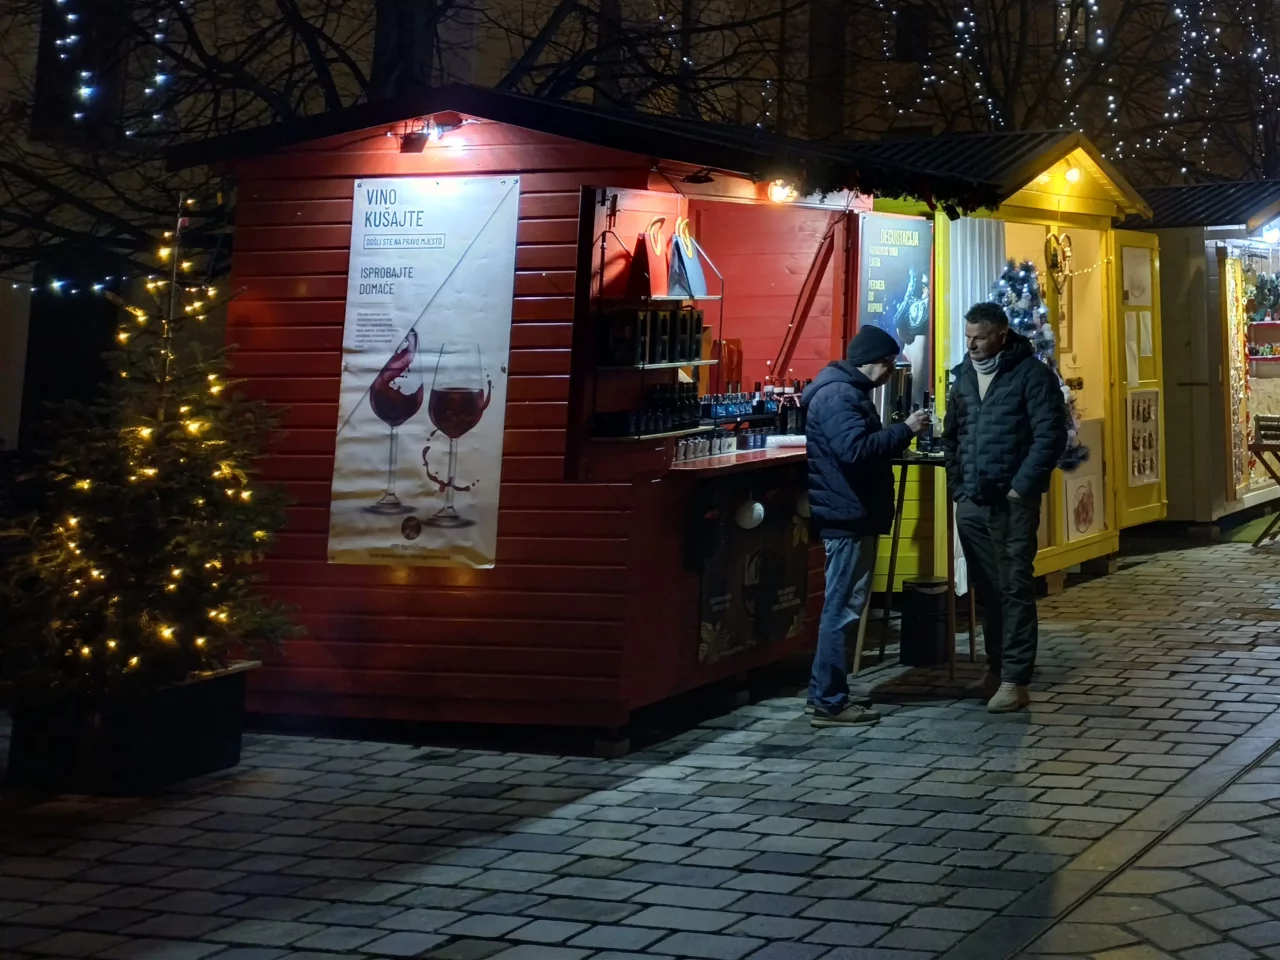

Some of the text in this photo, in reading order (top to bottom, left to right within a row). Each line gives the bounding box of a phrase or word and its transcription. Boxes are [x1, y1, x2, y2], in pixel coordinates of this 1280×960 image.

[367, 188, 397, 206] VINO
[364, 206, 424, 228] KUŠAJTE
[366, 237, 442, 246] DOŠLI STE NA PRAVO MJESTO
[360, 266, 414, 279] ISPROBAJTE
[359, 280, 395, 295] DOMAĆE
